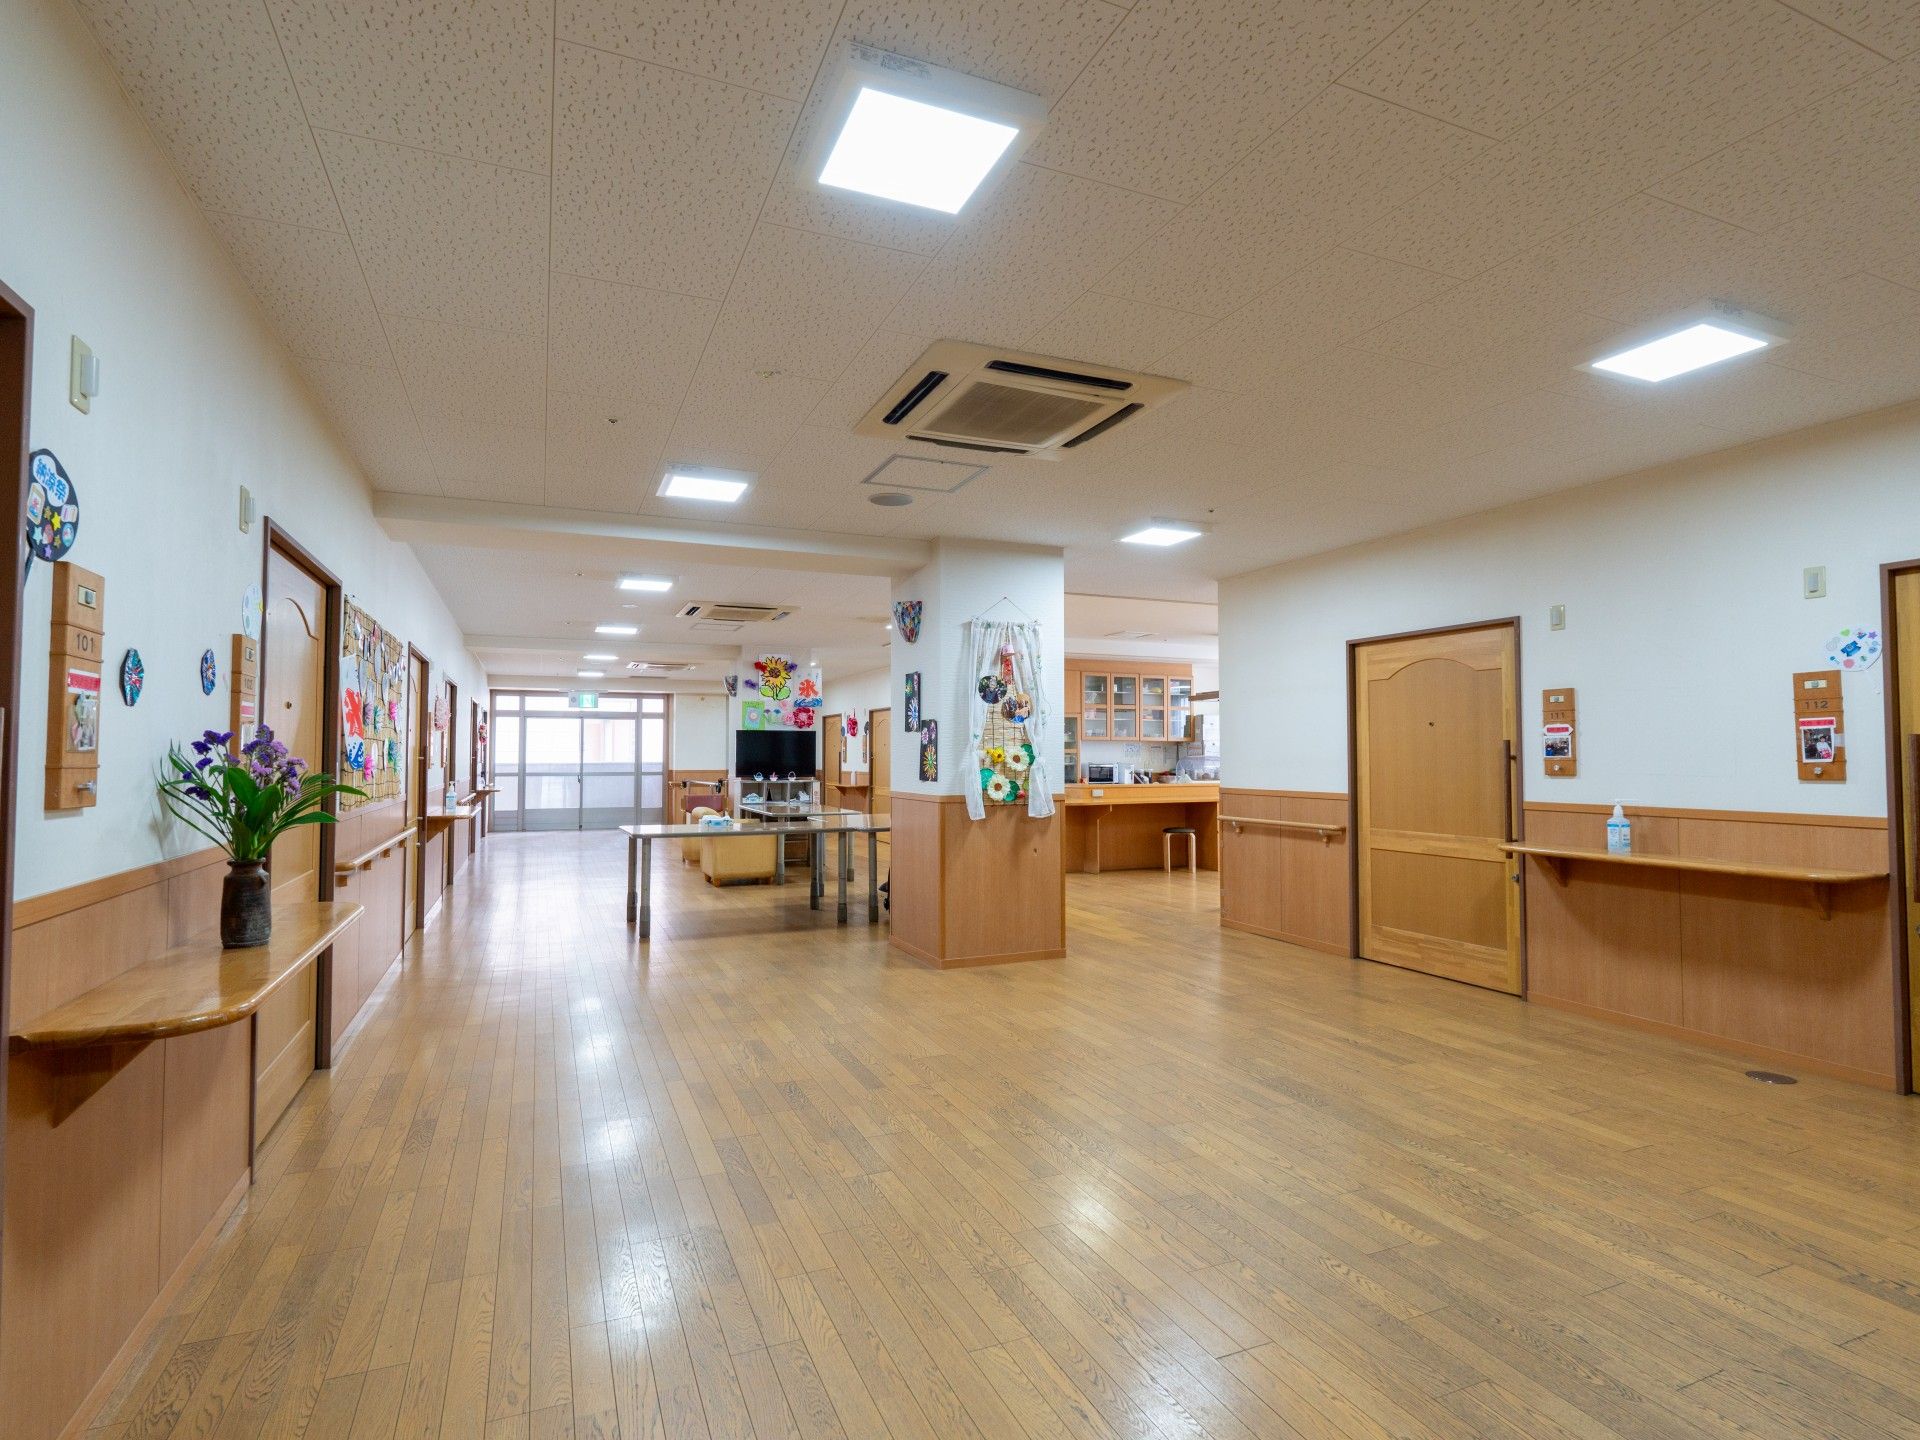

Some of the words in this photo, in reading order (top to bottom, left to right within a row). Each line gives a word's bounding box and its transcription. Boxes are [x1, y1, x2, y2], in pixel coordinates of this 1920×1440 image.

[76, 633, 93, 653] 101
[799, 679, 819, 698] 氷
[1805, 700, 1828, 709] 112
